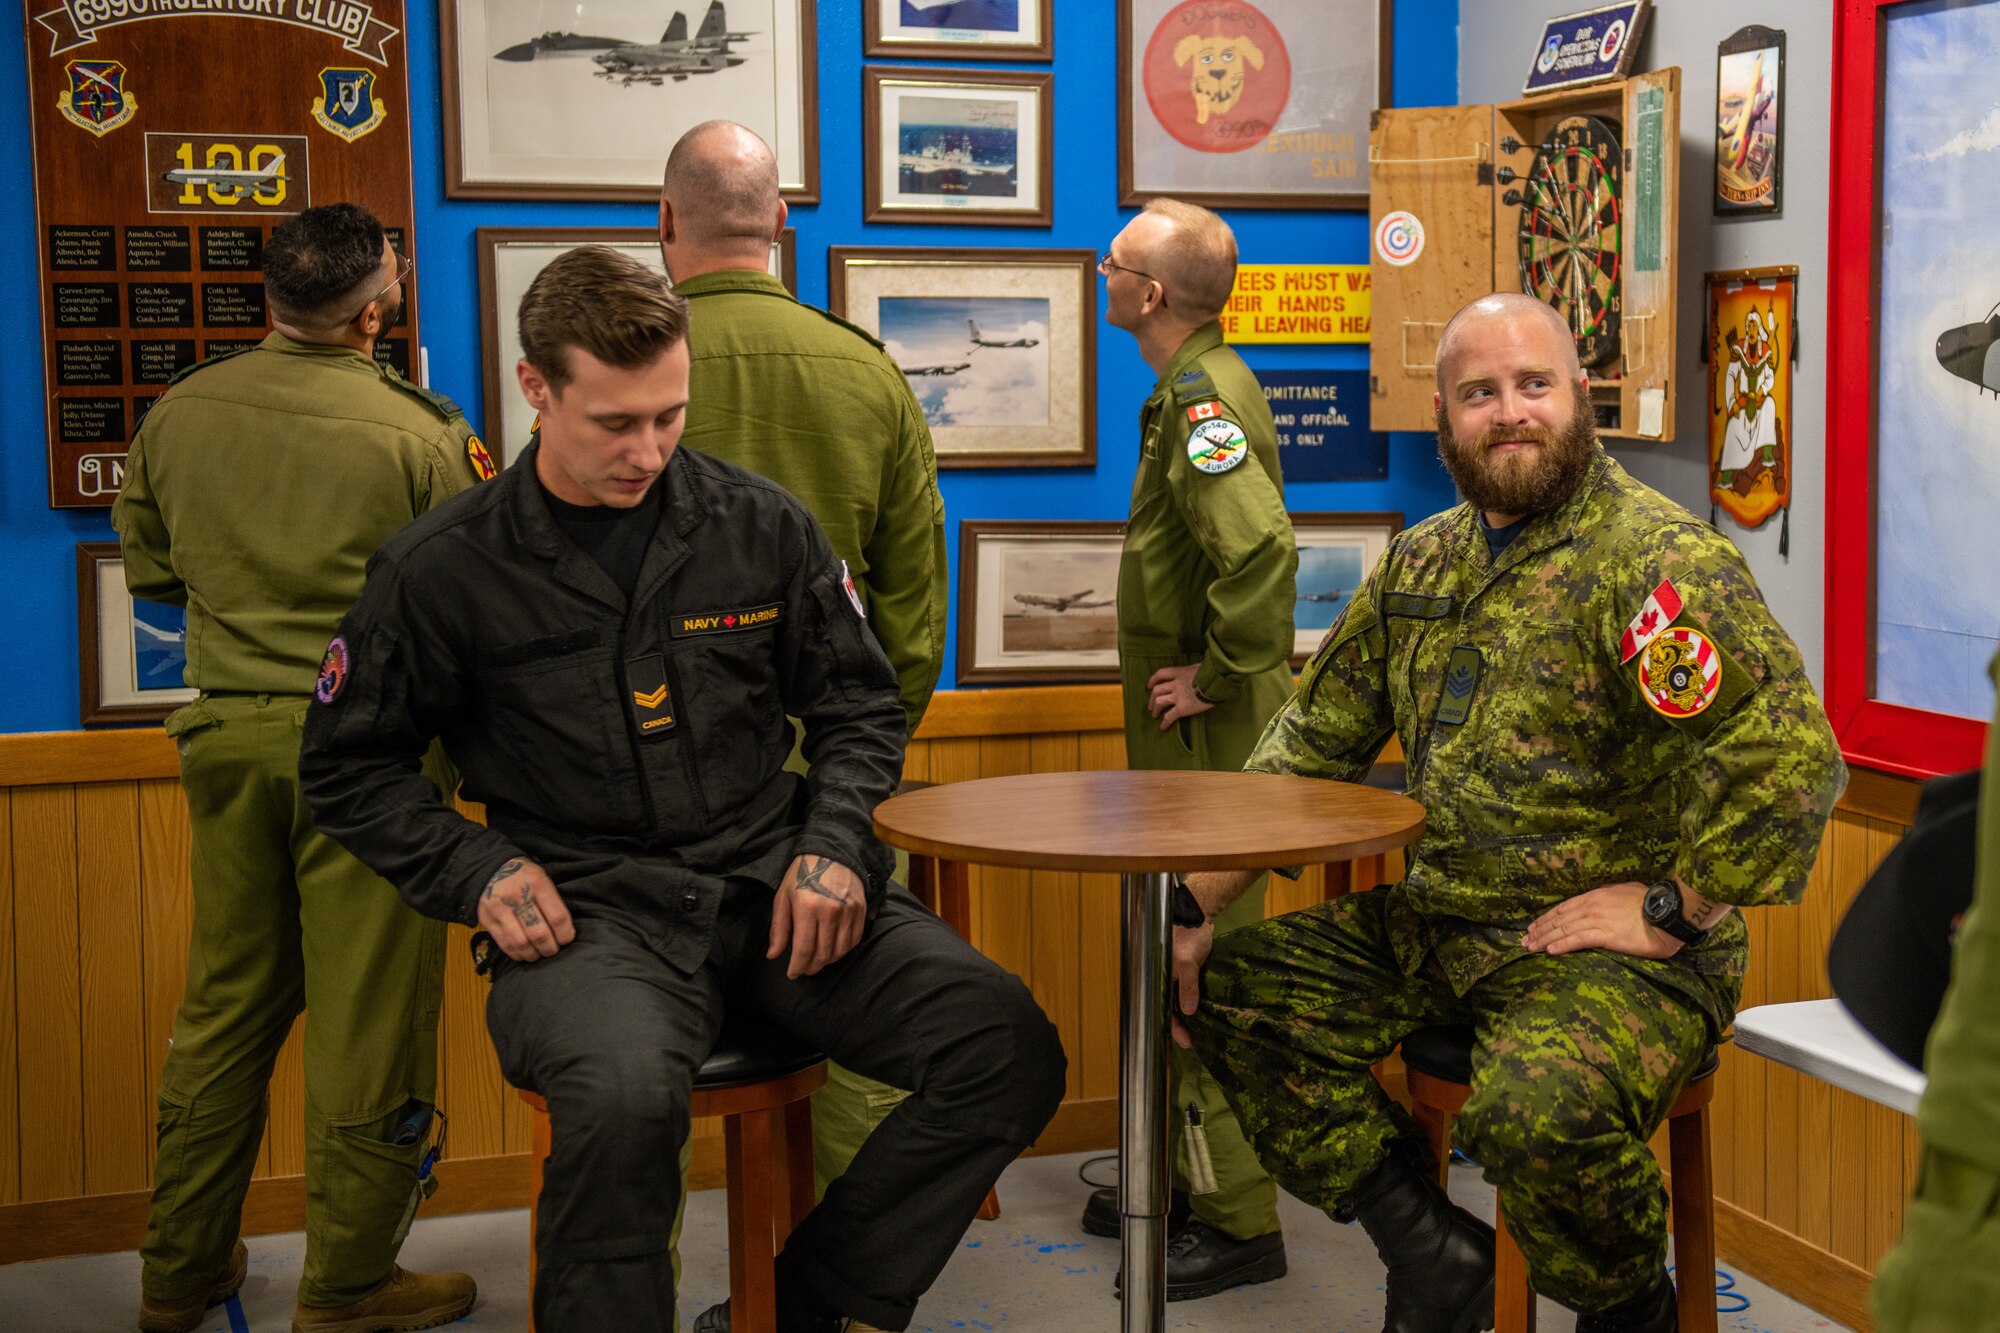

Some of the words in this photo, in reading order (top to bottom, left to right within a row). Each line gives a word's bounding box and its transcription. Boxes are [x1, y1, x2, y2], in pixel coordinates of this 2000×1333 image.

[296, 0, 362, 34] CLUB
[176, 142, 286, 206] 100
[233, 258, 249, 266] Gary
[1238, 272, 1276, 291] EES
[1284, 272, 1340, 291] MUST
[1346, 272, 1371, 291] WA
[1278, 296, 1346, 312] HANDS
[1254, 316, 1332, 333] LEAVING
[1264, 386, 1338, 400] DMITTANCE
[1301, 414, 1350, 426] OFFICIAL
[1196, 422, 1228, 438] CP-140
[1296, 434, 1324, 446] ONLY
[1205, 455, 1240, 470] AURORA
[684, 617, 720, 631] NAVY
[739, 608, 779, 626] MARINE
[642, 716, 673, 730] CANADA
